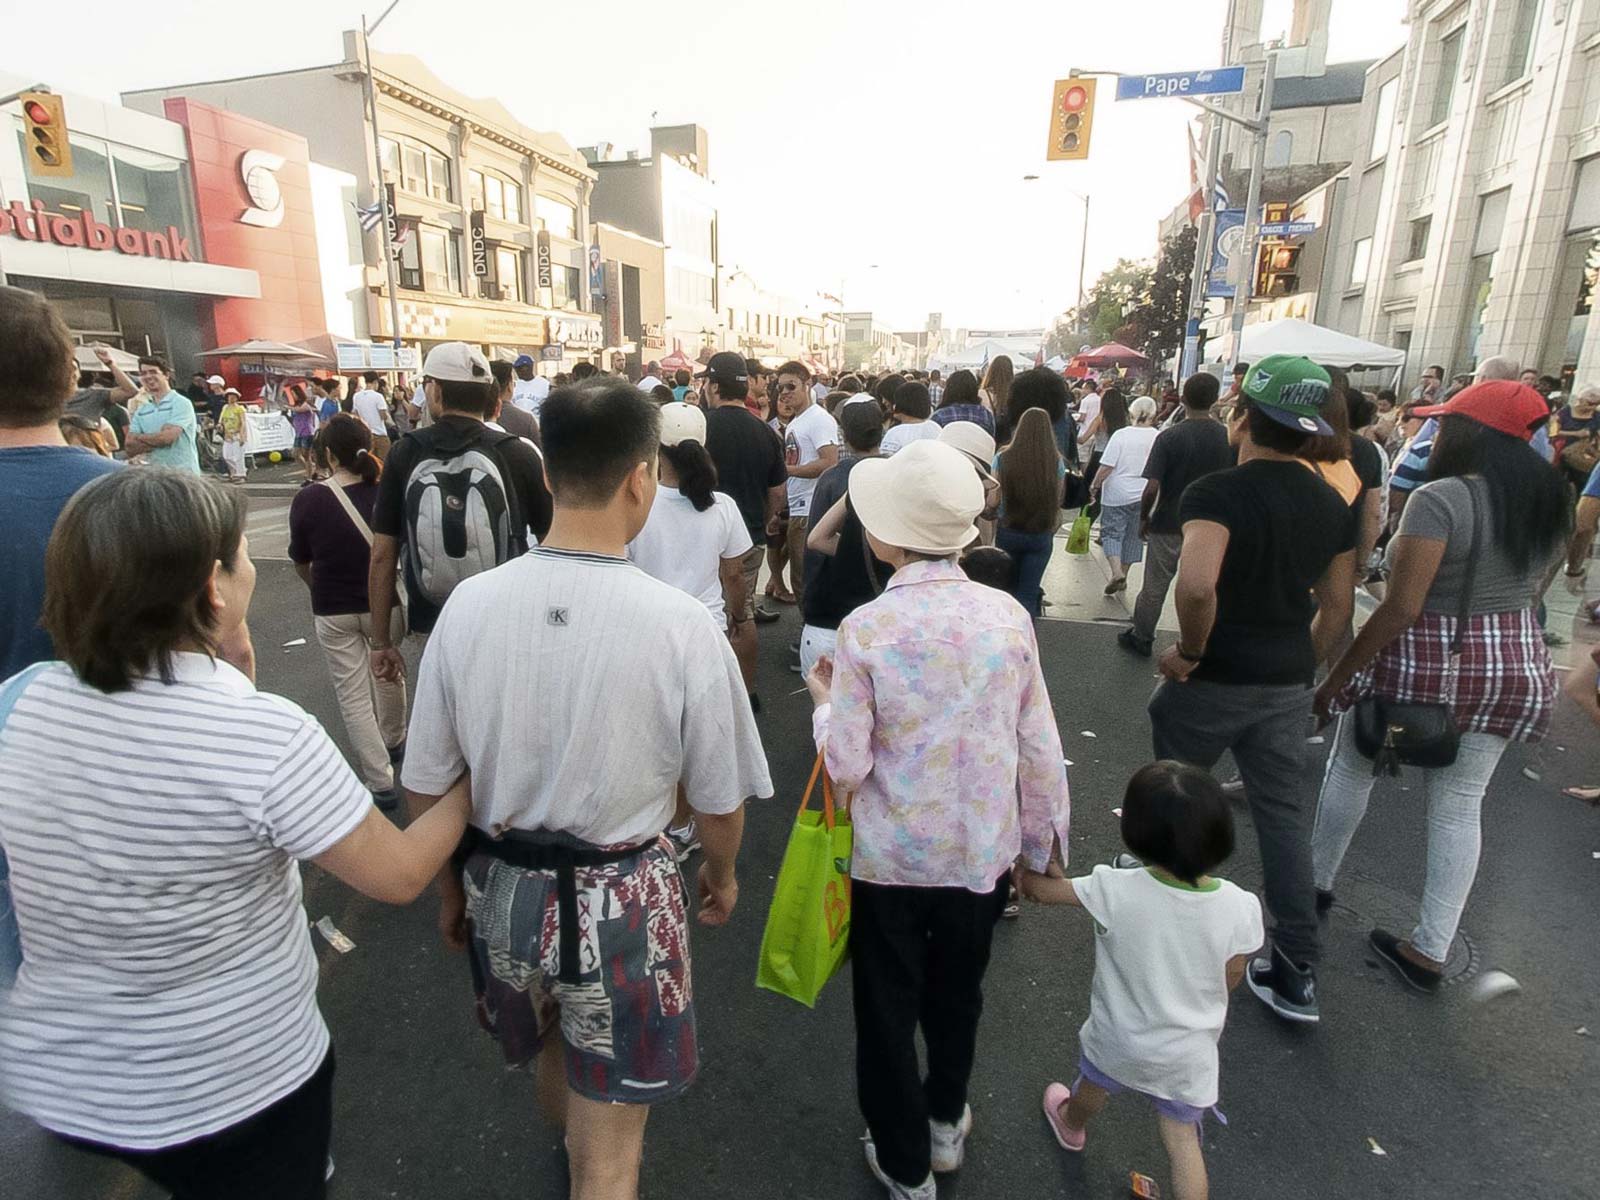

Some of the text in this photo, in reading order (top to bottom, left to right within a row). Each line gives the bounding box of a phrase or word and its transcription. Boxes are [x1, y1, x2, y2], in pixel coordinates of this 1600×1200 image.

[1144, 76, 1191, 96] Pape
[472, 227, 487, 275] DNDC
[539, 246, 550, 286] DNDC
